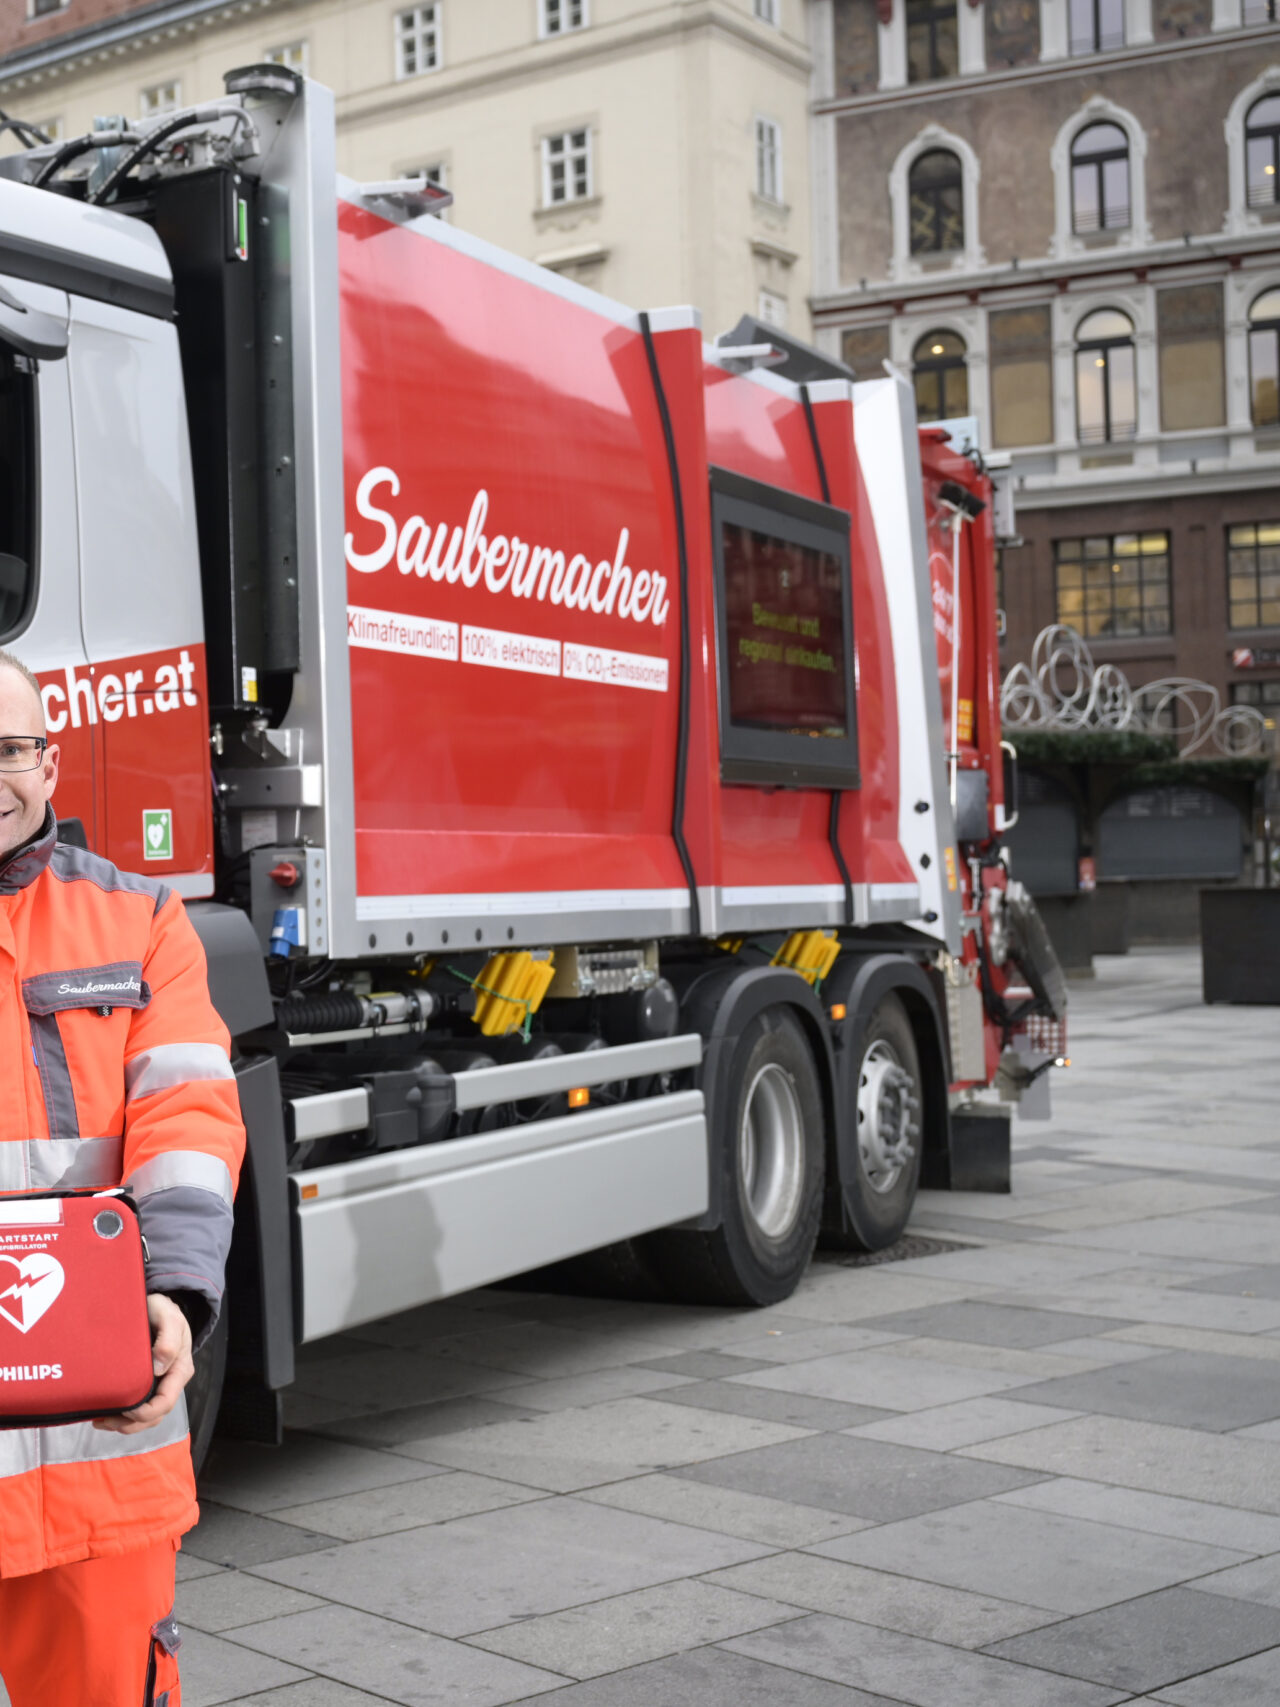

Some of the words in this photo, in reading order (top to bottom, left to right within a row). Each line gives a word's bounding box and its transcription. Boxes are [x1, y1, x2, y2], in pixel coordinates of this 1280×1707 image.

[344, 466, 669, 626] Saubermacher
[346, 612, 456, 652] Klimafreundlich
[465, 633, 497, 660] 100%
[501, 639, 559, 667] elektrisch
[564, 650, 582, 673] 0%
[57, 976, 141, 994] Saubermache
